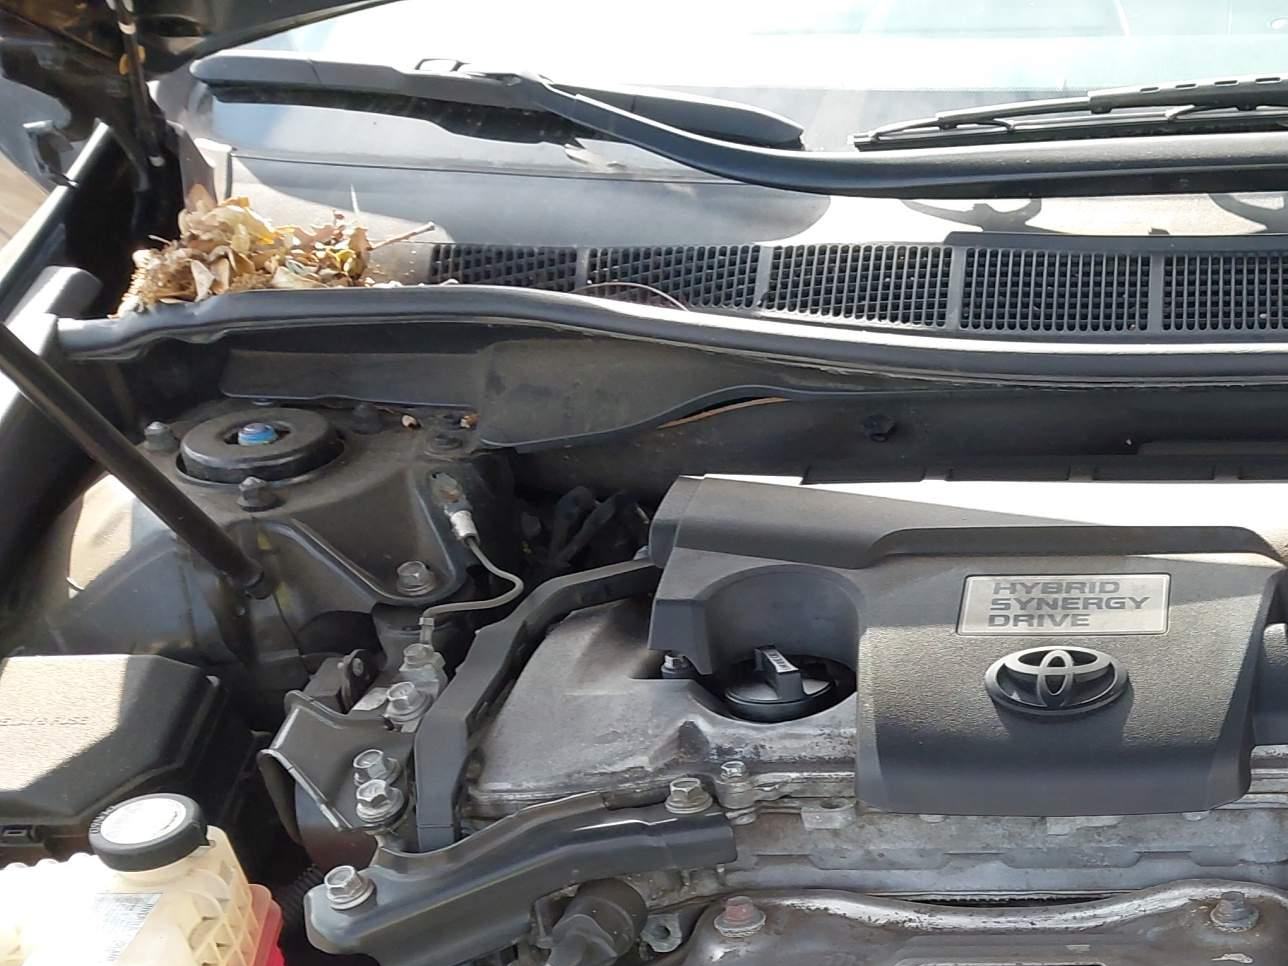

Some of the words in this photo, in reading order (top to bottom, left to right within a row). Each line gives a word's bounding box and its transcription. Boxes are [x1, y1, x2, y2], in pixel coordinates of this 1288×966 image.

[993, 581, 1120, 595] HYBRID
[989, 596, 1152, 611] SYNERGY
[988, 613, 1091, 627] DRIVE
